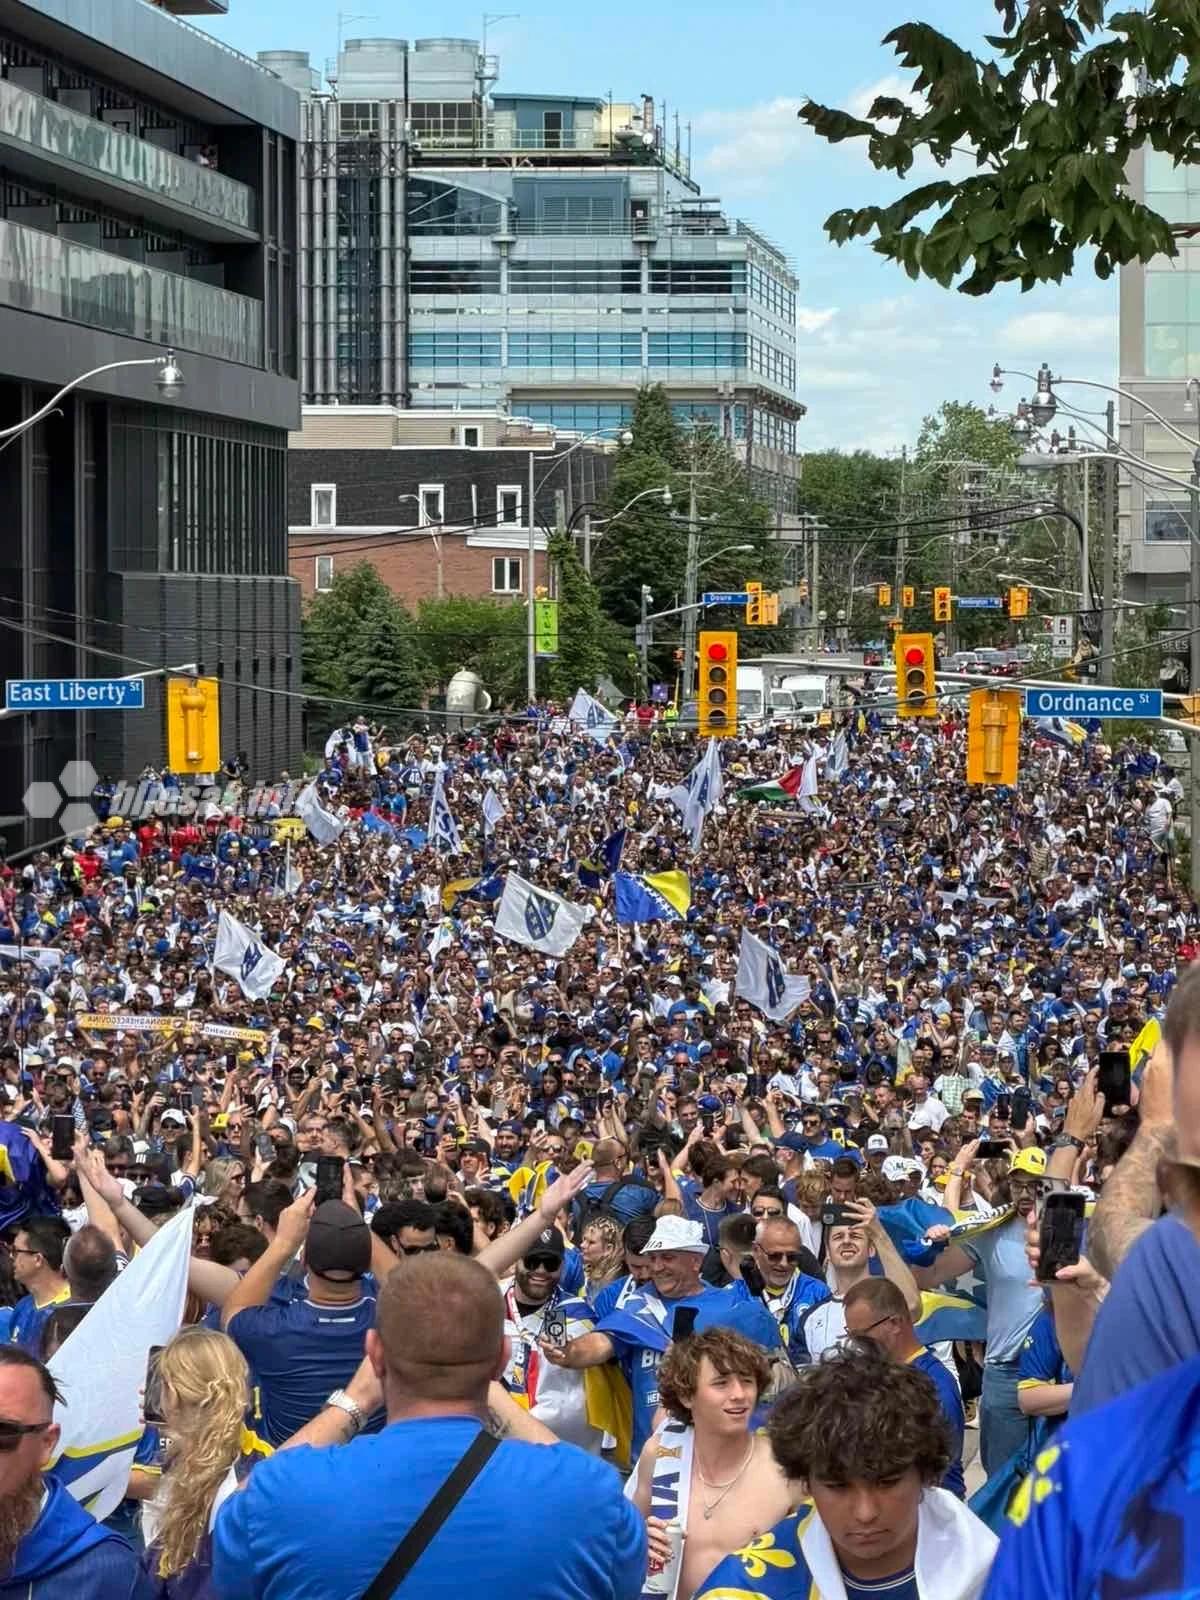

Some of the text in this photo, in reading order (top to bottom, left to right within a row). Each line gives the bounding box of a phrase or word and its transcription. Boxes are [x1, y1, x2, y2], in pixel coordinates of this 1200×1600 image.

[10, 682, 140, 704] East Liberty St
[1038, 692, 1150, 712] Ordnance St
